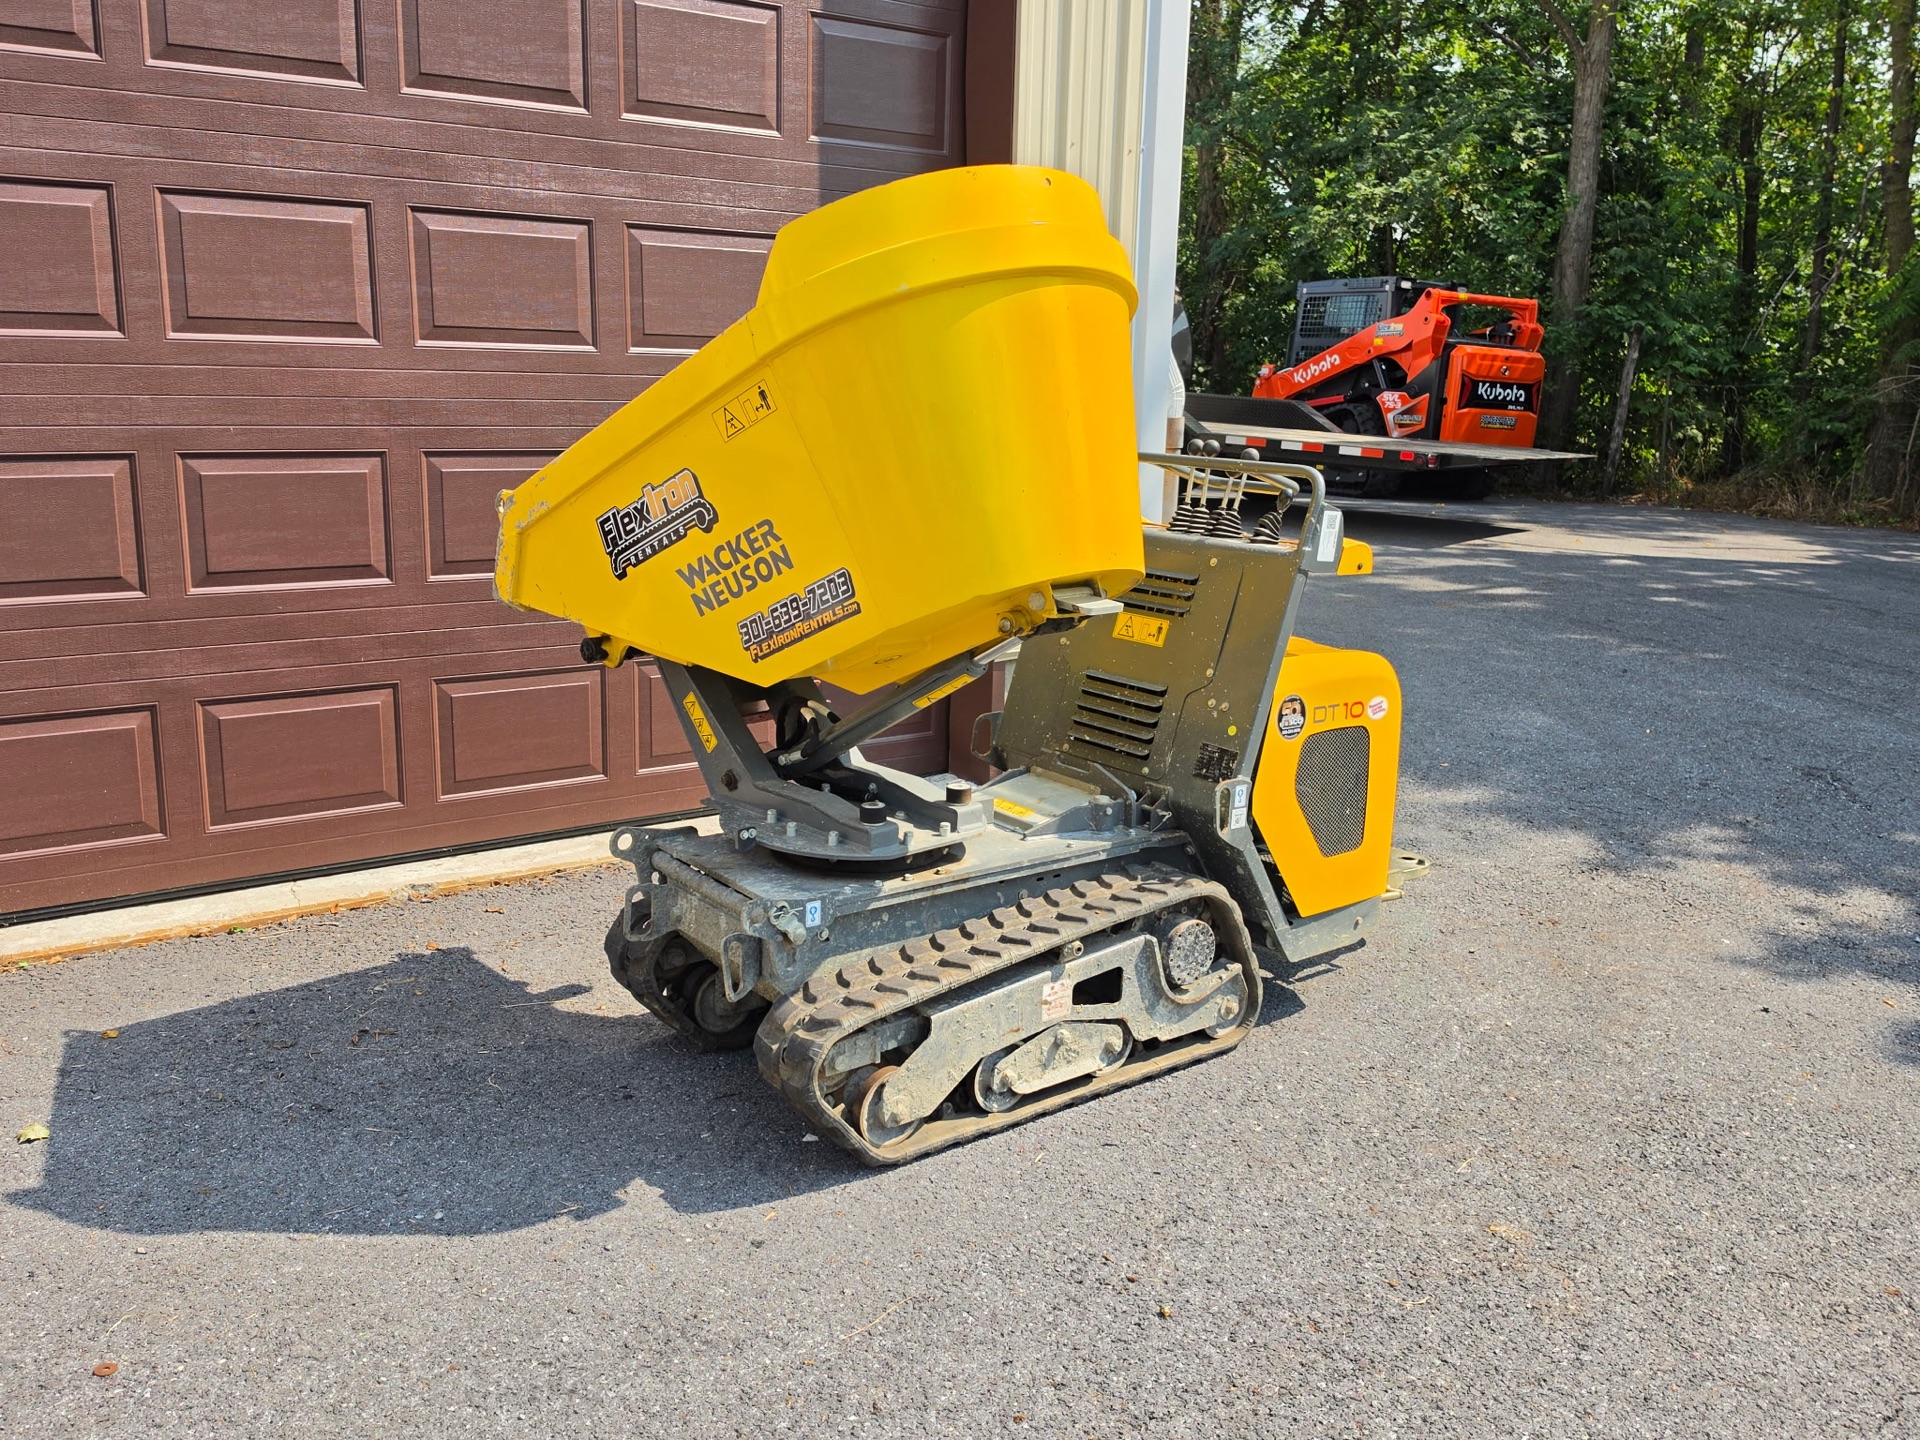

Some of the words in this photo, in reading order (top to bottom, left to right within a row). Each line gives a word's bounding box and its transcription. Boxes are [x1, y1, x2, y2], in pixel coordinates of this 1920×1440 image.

[1293, 354, 1341, 383] Kubota
[1381, 393, 1401, 401] SVL
[1477, 382, 1526, 402] Kubota
[630, 526, 686, 565] RENTALS
[675, 518, 782, 589] WACKER
[690, 545, 794, 617] NEUSON
[738, 569, 853, 648] 301-639-7203
